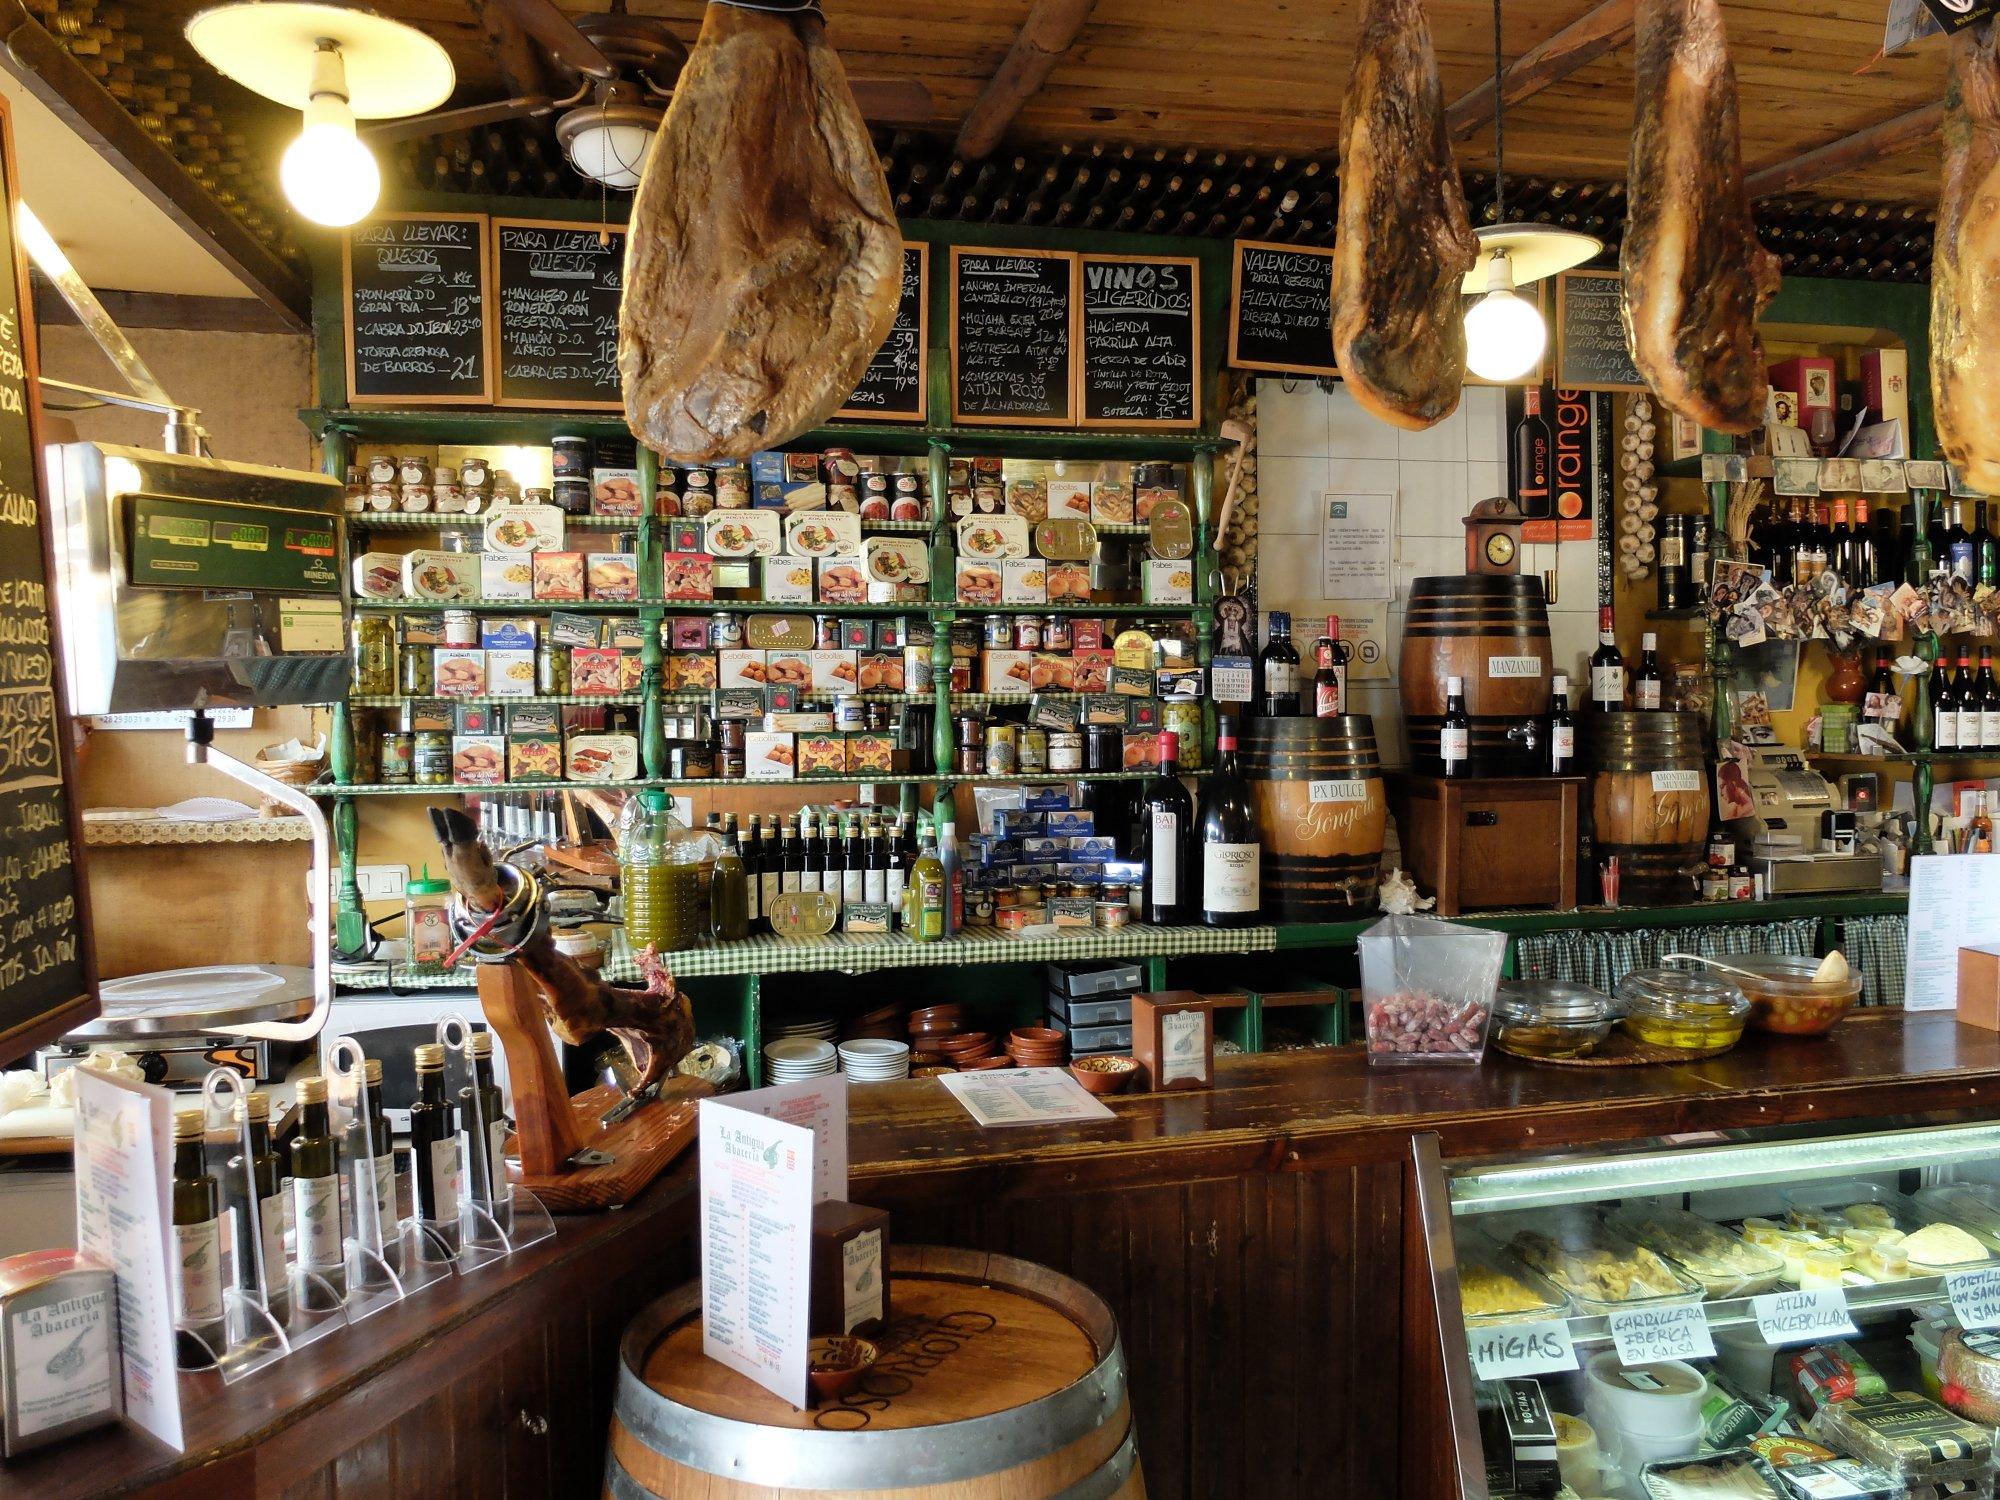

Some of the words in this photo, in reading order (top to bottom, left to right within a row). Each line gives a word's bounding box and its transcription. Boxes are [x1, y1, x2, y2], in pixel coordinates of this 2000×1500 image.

[356, 226, 395, 242] PARA
[502, 232, 547, 248] PARA
[377, 248, 437, 265] QUESOS
[530, 253, 596, 272] QUESOS
[961, 260, 990, 271] PARA
[1087, 266, 1179, 290] VINOS
[1250, 272, 1279, 284] RIOJA
[1283, 274, 1324, 290] RESERVA
[965, 281, 1000, 292] ANCHOA
[573, 291, 589, 303] AL
[359, 302, 392, 313] GRAN
[1242, 309, 1280, 324] RIBERA
[1283, 314, 1319, 327] DUERO
[364, 323, 405, 336] CABRA
[595, 315, 619, 336] 24
[964, 327, 984, 336] DE
[1086, 318, 1149, 334] HACIENDA
[965, 342, 1020, 354] VENTRESCA
[1086, 336, 1138, 348] PARRILLA
[362, 346, 401, 357] TORTA
[1091, 356, 1130, 365] TIERRA
[1133, 356, 1148, 365] DE
[360, 362, 380, 373] DE
[385, 362, 435, 373] BARROS
[450, 355, 478, 381] 21
[965, 372, 1024, 382] CONSERVAS
[1030, 373, 1046, 383] DE
[1010, 383, 1046, 399] ROJO
[963, 401, 976, 410] DE
[1156, 406, 1176, 419] 15
[768, 557, 792, 565] Fabes
[1005, 560, 1027, 568] Fabes
[303, 570, 336, 581] MINERVA
[722, 652, 753, 660] Cebollas
[814, 652, 844, 660] Cebollas
[1491, 659, 1540, 675] MANZANILLA
[1314, 784, 1328, 798] PX
[1330, 783, 1364, 797] DULCE
[1214, 850, 1255, 859] GLORIOSO
[719, 1125, 731, 1141] La
[734, 1130, 765, 1150] Antigua
[844, 1247, 853, 1256] La
[1949, 1270, 2000, 1290] TORTILL
[1951, 1290, 1969, 1303] CON
[20, 1310, 41, 1325] La
[50, 1291, 108, 1317] Antigua
[1962, 1308, 1971, 1322] Y
[1615, 1309, 1704, 1331] CARRILLERA
[1762, 1310, 1851, 1334] ENCEBOLLADO
[1478, 1332, 1566, 1364] MIGAS
[1627, 1348, 1646, 1361] EN
[1650, 1344, 1695, 1360] SALSA
[1866, 1409, 1942, 1424] MERCADAL
[1711, 1405, 1748, 1445] HUERCASA
